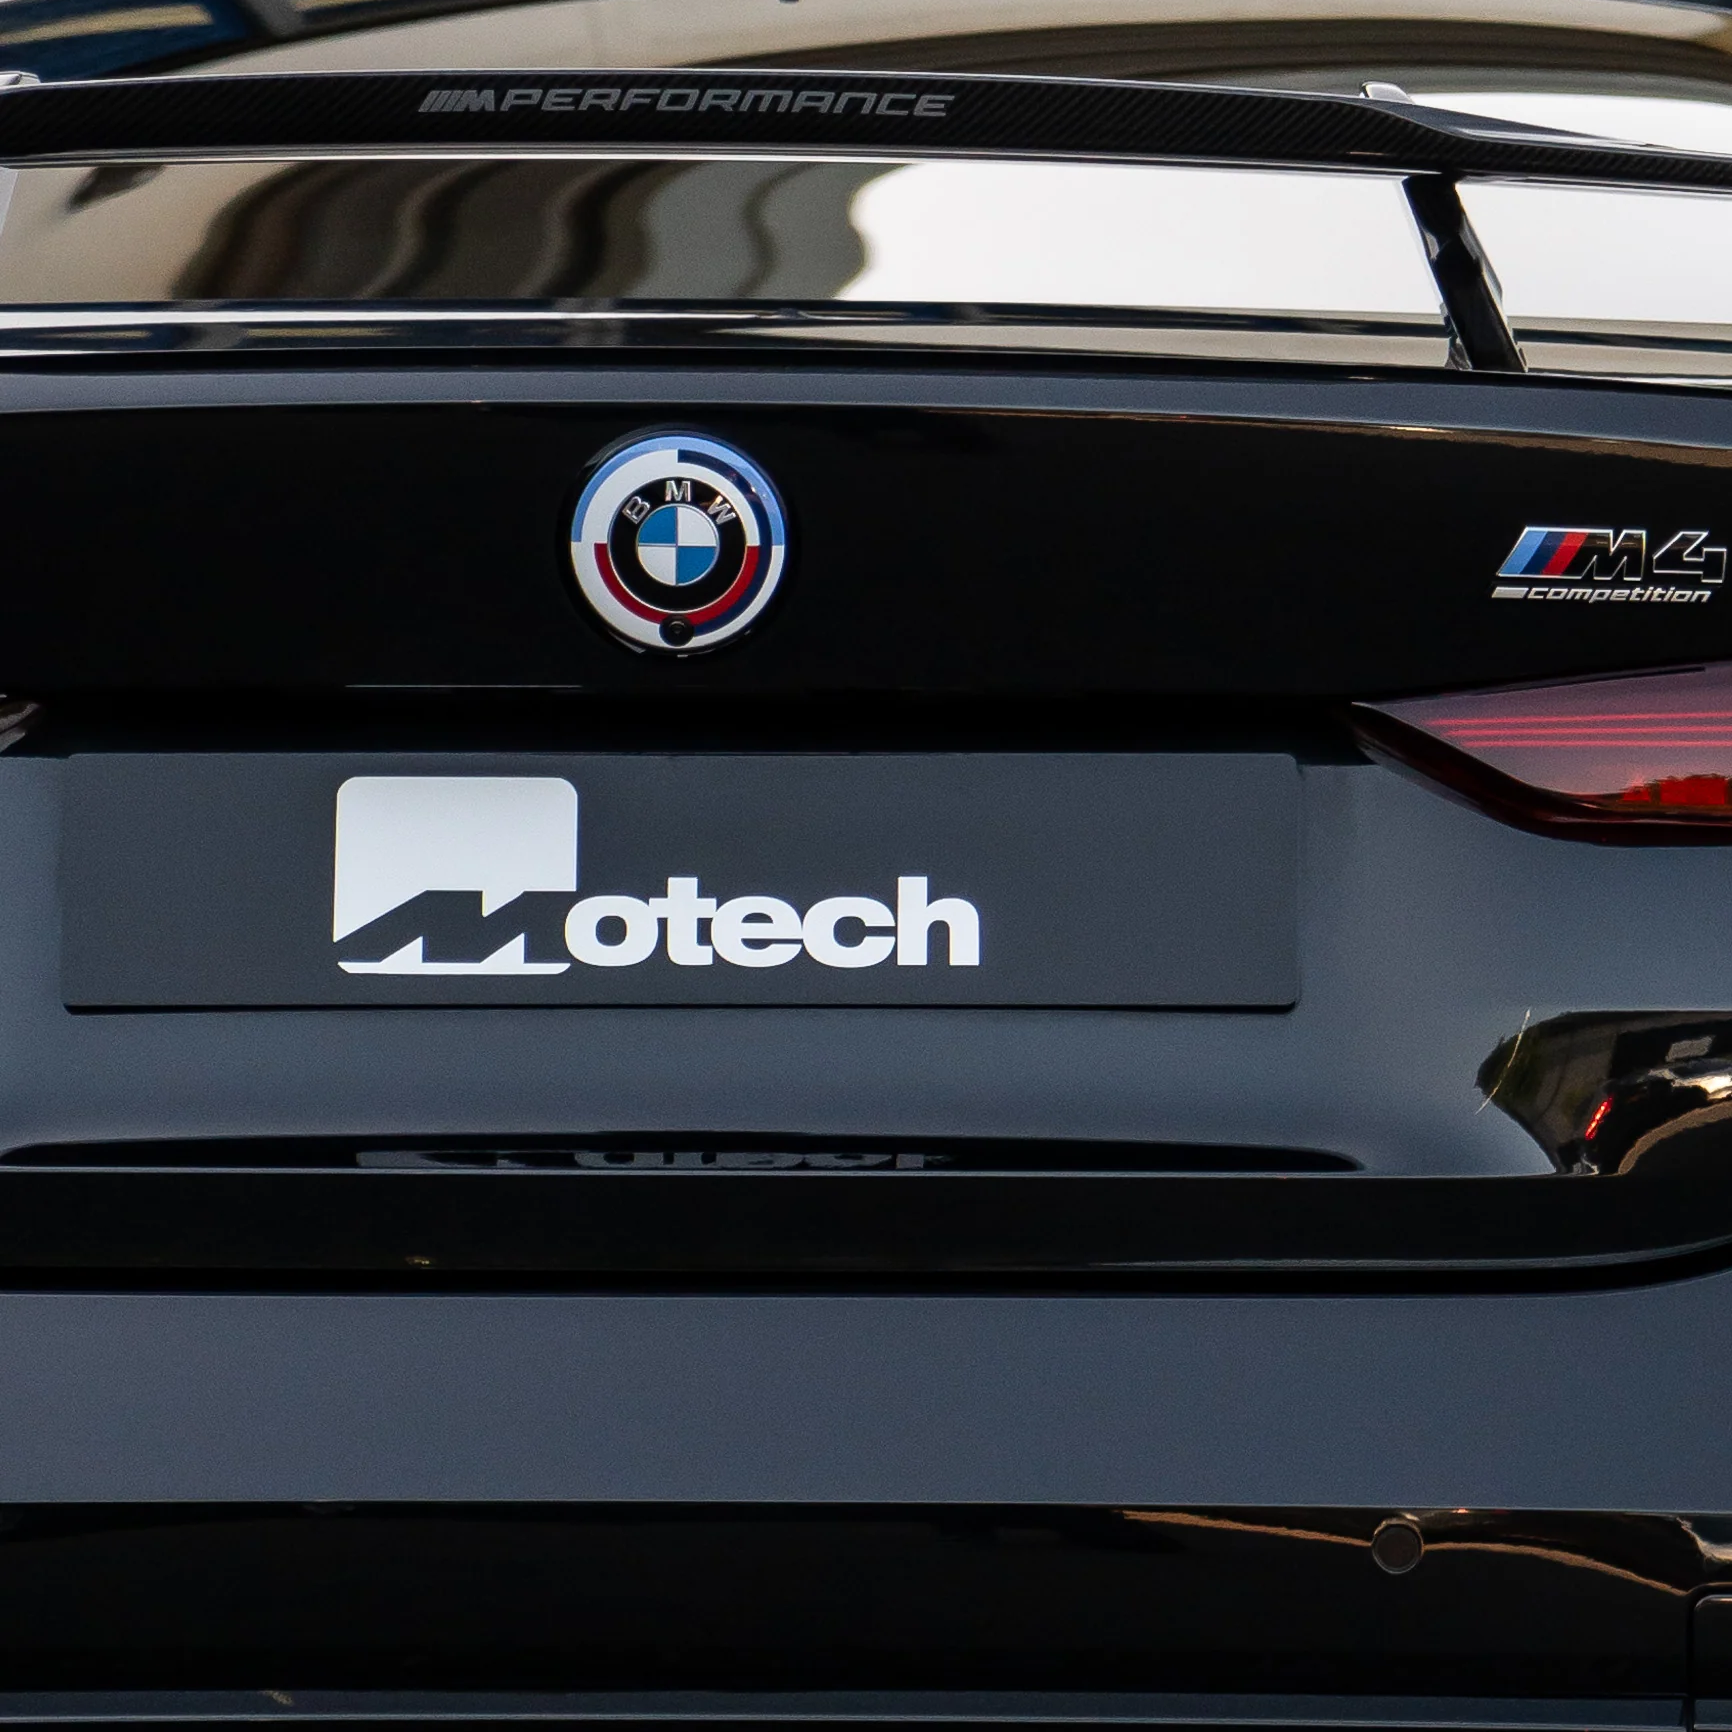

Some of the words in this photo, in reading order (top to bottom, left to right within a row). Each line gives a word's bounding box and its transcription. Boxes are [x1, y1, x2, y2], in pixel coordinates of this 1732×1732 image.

[622, 480, 737, 525] BMW
[1558, 529, 1727, 584] M4
[1527, 585, 1711, 604] competition
